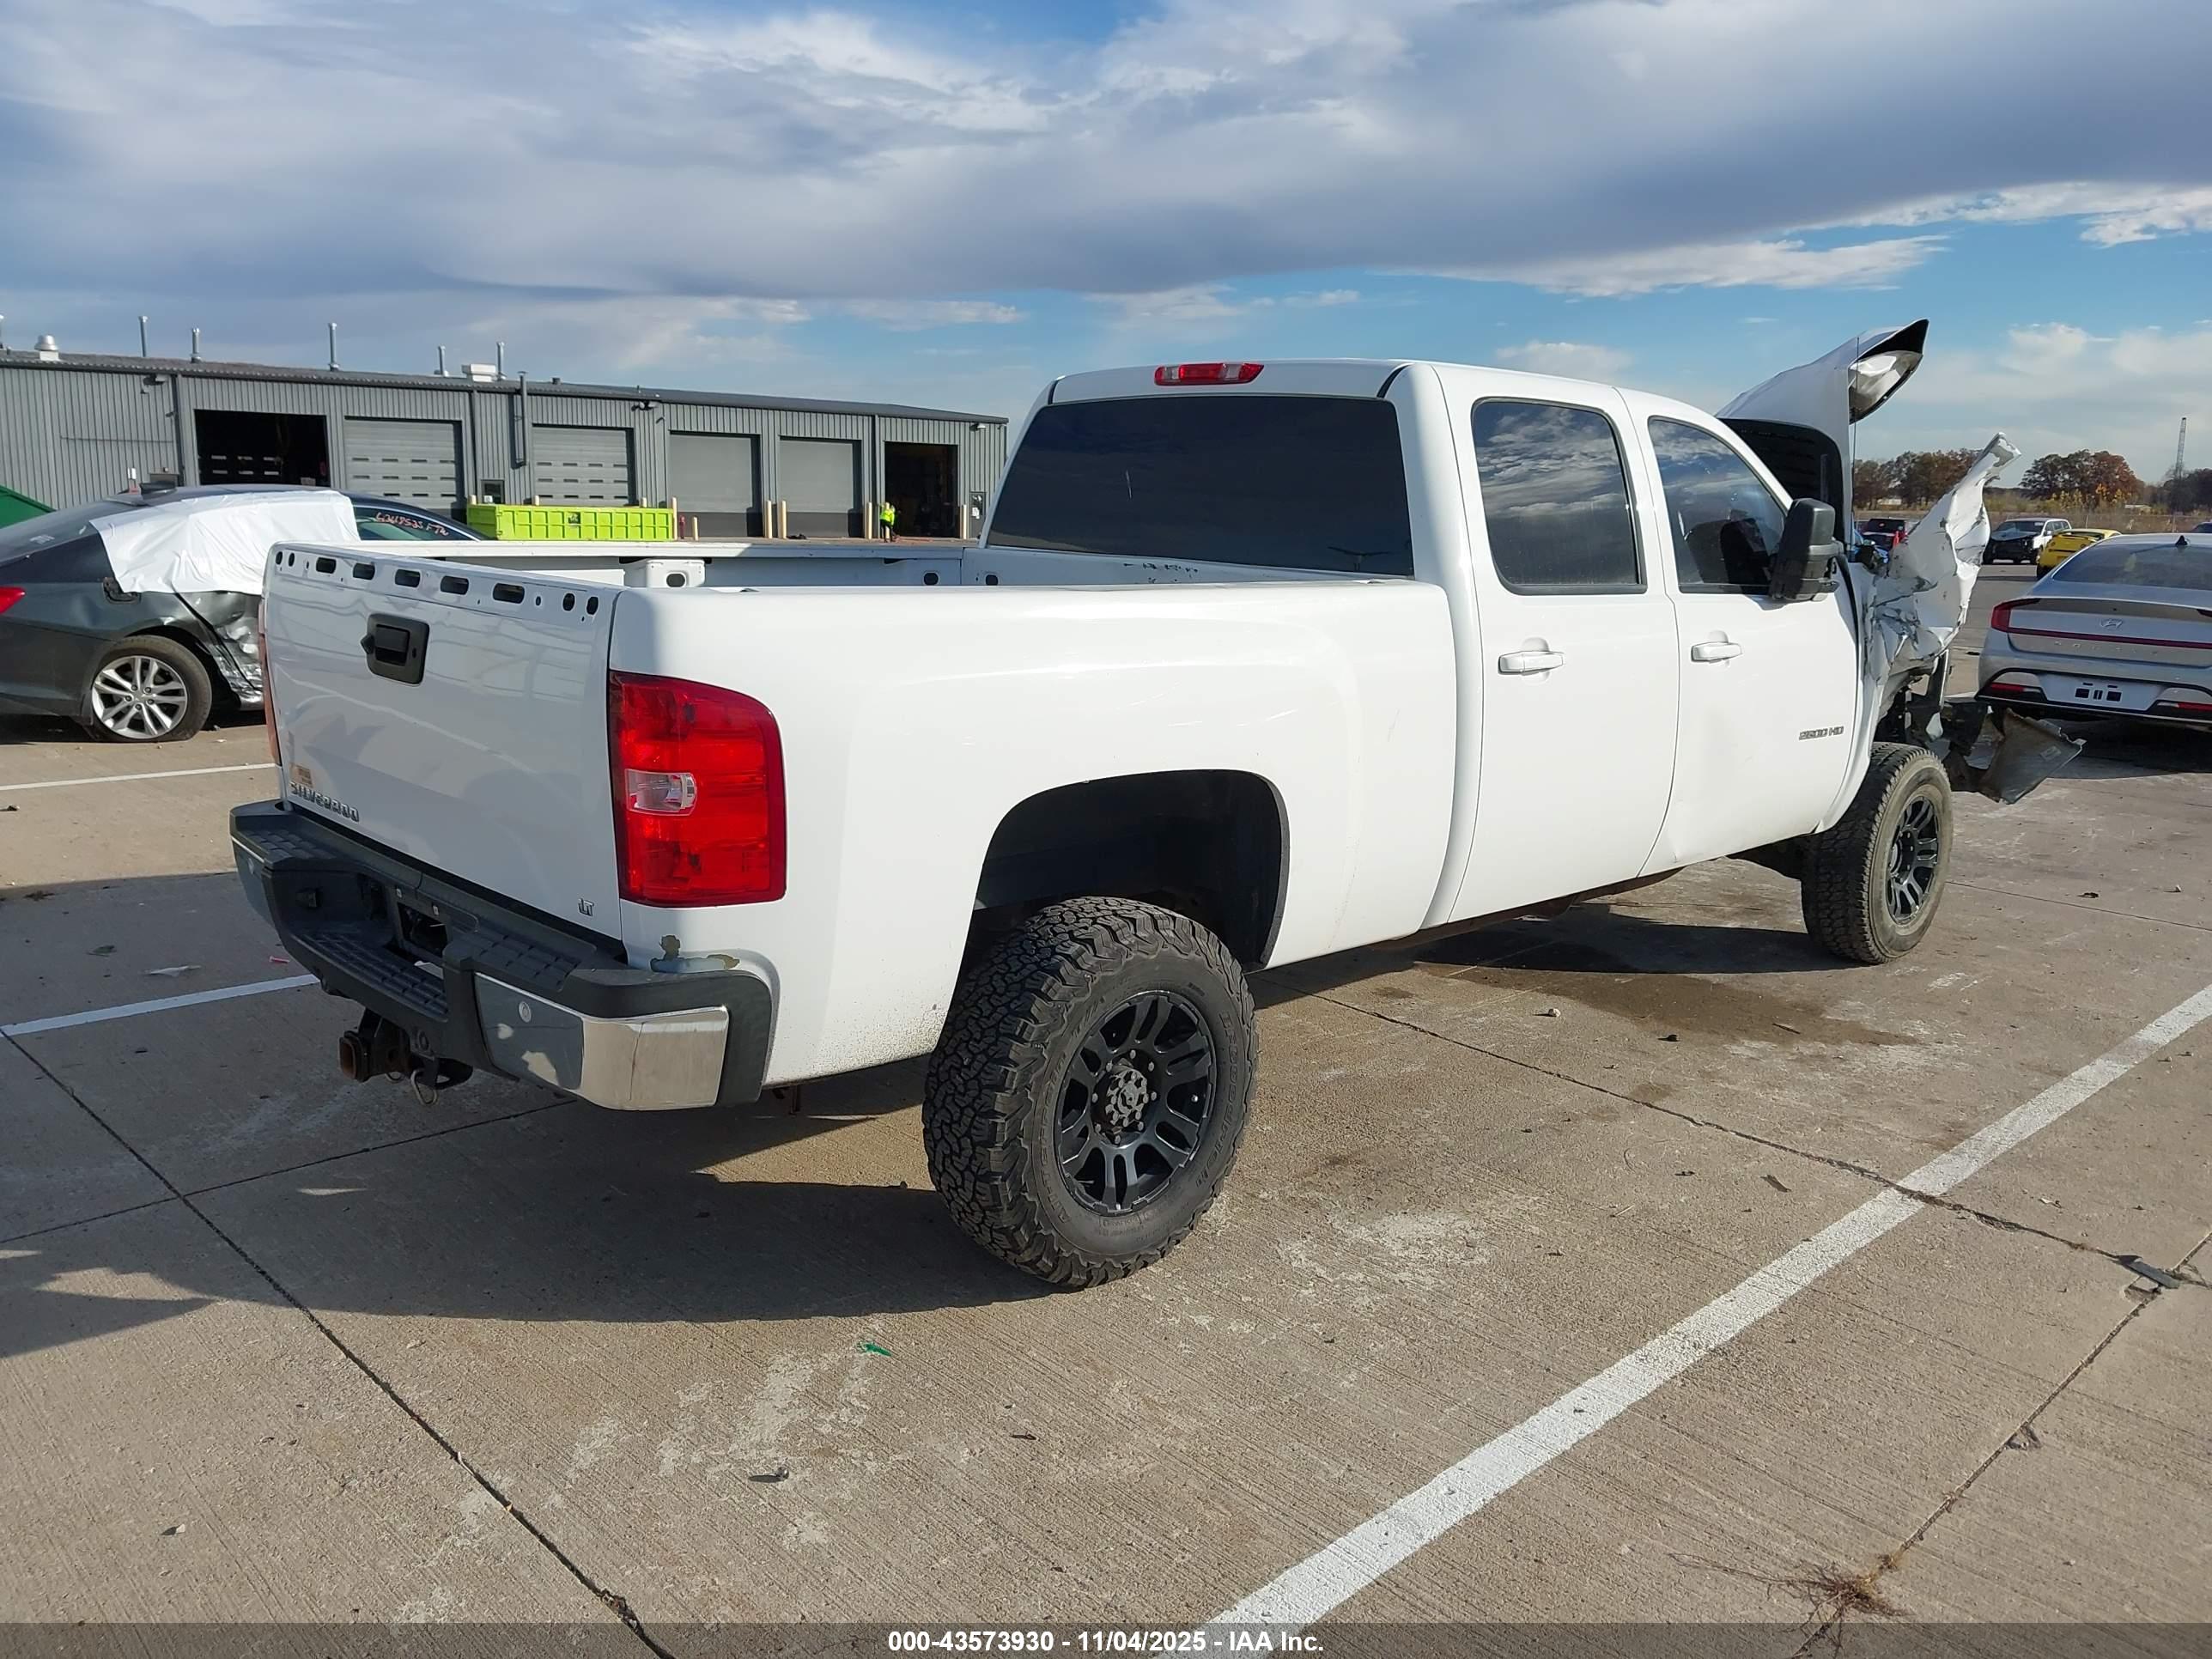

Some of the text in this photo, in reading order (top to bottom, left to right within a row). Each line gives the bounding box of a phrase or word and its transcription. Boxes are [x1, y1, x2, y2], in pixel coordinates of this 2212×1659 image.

[1799, 725, 1844, 740] 2500 HD
[290, 781, 360, 823] SILVERADO
[578, 898, 595, 917] LT
[1195, 1011, 1239, 1188] BFGoodrich
